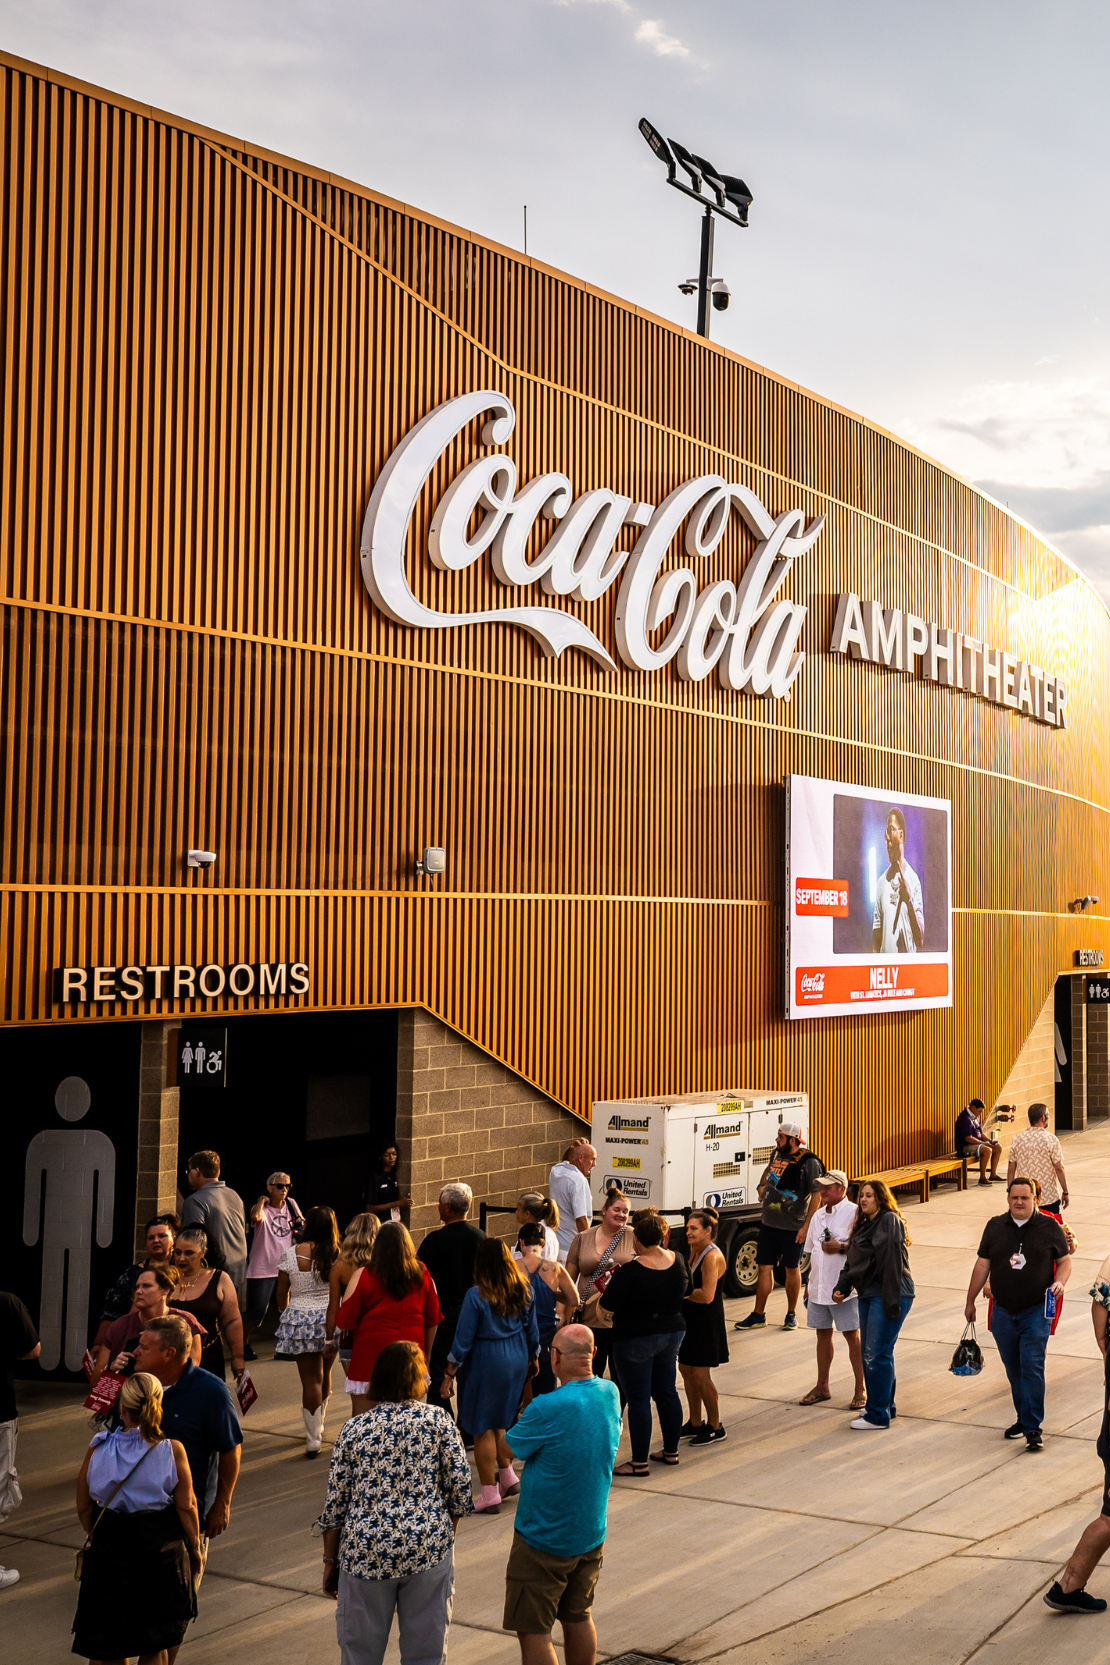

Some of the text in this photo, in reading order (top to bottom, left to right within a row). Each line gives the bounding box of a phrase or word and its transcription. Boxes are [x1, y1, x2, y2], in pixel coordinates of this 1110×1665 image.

[361, 389, 827, 702] Coca-Cola
[830, 592, 1068, 730] AMPHITHEATER
[796, 888, 848, 907] SEPTEMBER 18
[61, 961, 310, 1002] RESTROOMS
[870, 967, 899, 989] NELLY
[766, 1097, 797, 1106] MAXI-POWER
[607, 1115, 650, 1130] Allmand
[704, 1121, 741, 1139] Allmand
[605, 1137, 642, 1145] MAXI-POWER
[705, 1142, 720, 1152] H-20
[623, 1180, 647, 1189] United
[623, 1188, 648, 1196] Rentals
[722, 1190, 743, 1200] United
[722, 1197, 744, 1207] Rentals
